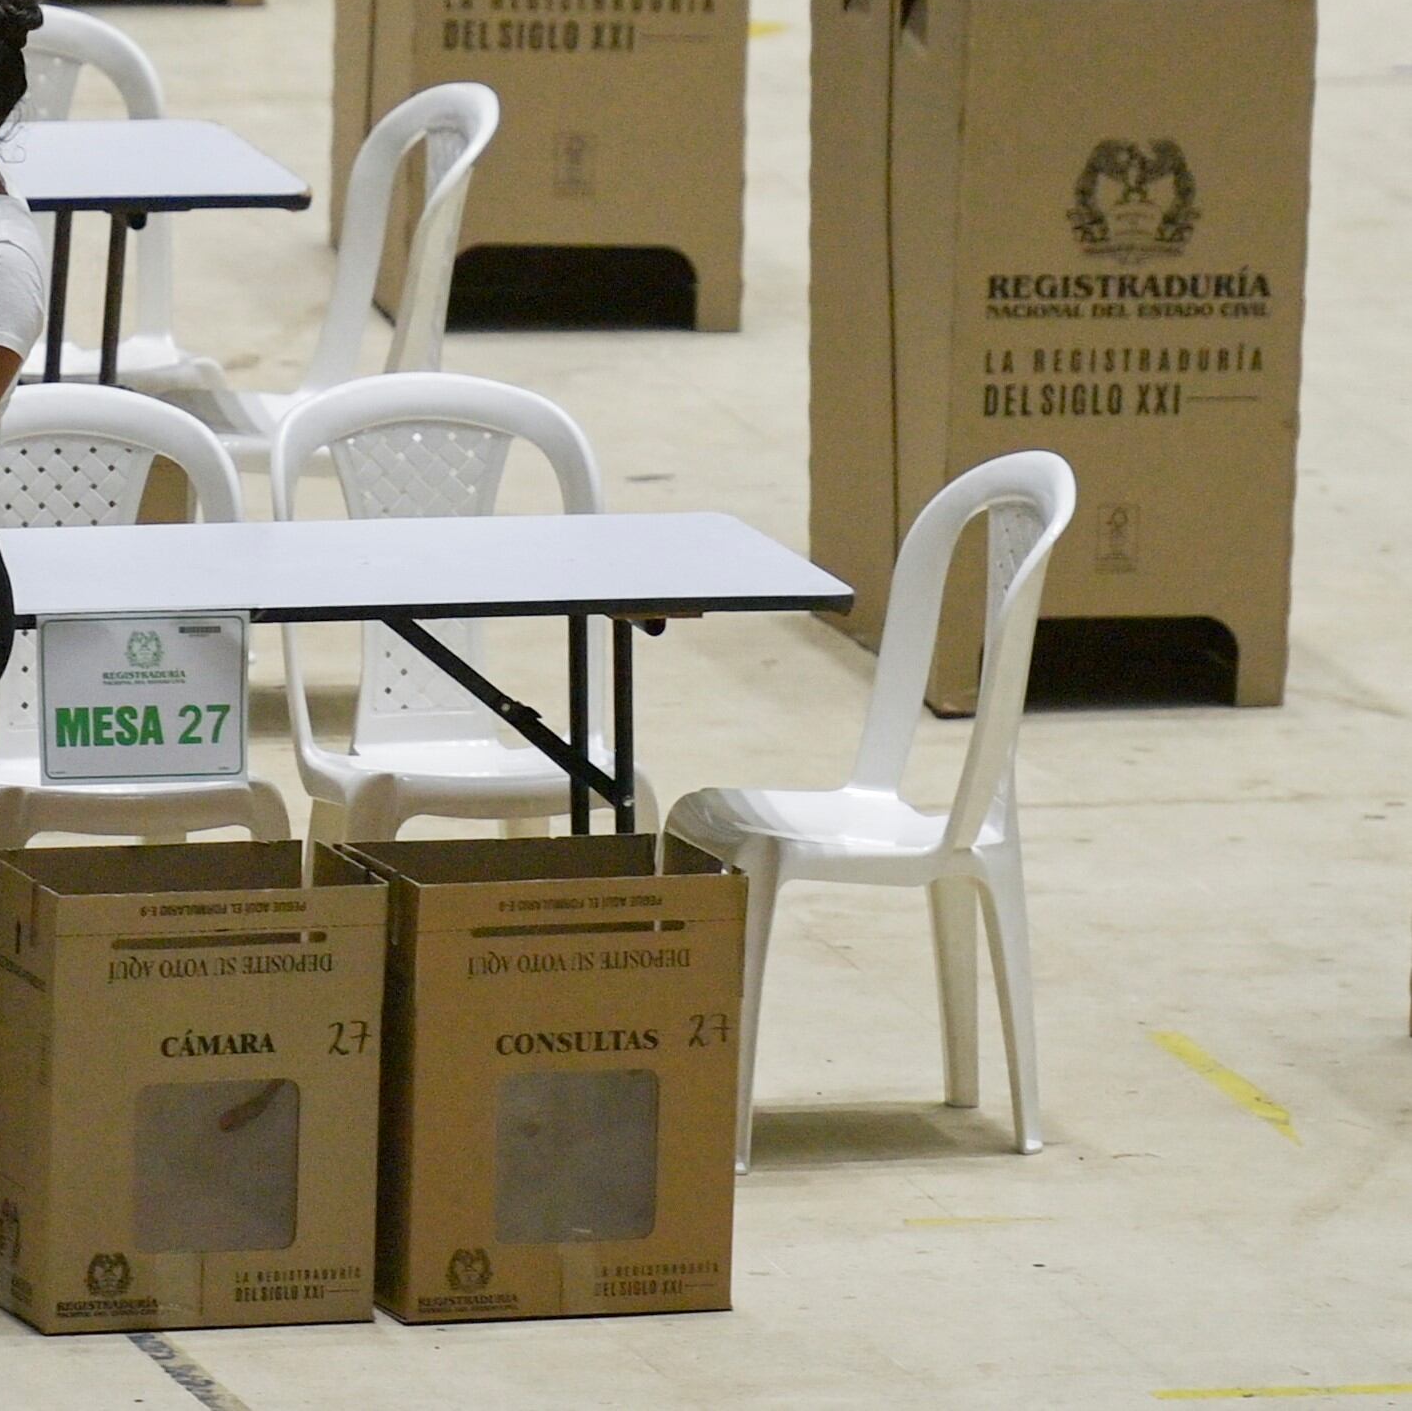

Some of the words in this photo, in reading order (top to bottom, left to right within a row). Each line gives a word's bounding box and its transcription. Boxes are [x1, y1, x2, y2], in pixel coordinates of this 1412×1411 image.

[499, 19, 579, 50] SIGLO
[987, 265, 1271, 299] REGISTRADURÍA
[986, 303, 1084, 319] NACIONAL
[1091, 303, 1128, 318] DEL
[1137, 302, 1214, 318] ESTADO
[1220, 302, 1269, 317] CIVIL
[985, 348, 1014, 374] LA
[1033, 342, 1264, 373] REGISTRADURÍA
[984, 384, 1031, 416] DEL
[1041, 384, 1123, 416] SIGLO
[1137, 384, 1180, 415] XXI
[55, 705, 165, 748] MESA
[178, 704, 231, 744] 27
[108, 956, 154, 984] AQUÍ
[159, 958, 208, 977] VOTO
[214, 957, 237, 975] SU
[242, 953, 332, 975] DEPOSITE
[468, 951, 509, 979] AQUÍ
[518, 954, 567, 973] VOTO
[573, 952, 594, 970] SU
[600, 948, 690, 970] DEPOSITE
[161, 1029, 275, 1058] CÁMARA
[328, 1020, 371, 1055] 27
[496, 1029, 659, 1056] CONSULTAS
[688, 1013, 730, 1047] 27
[56, 1295, 159, 1312] REGISTRADURÍA
